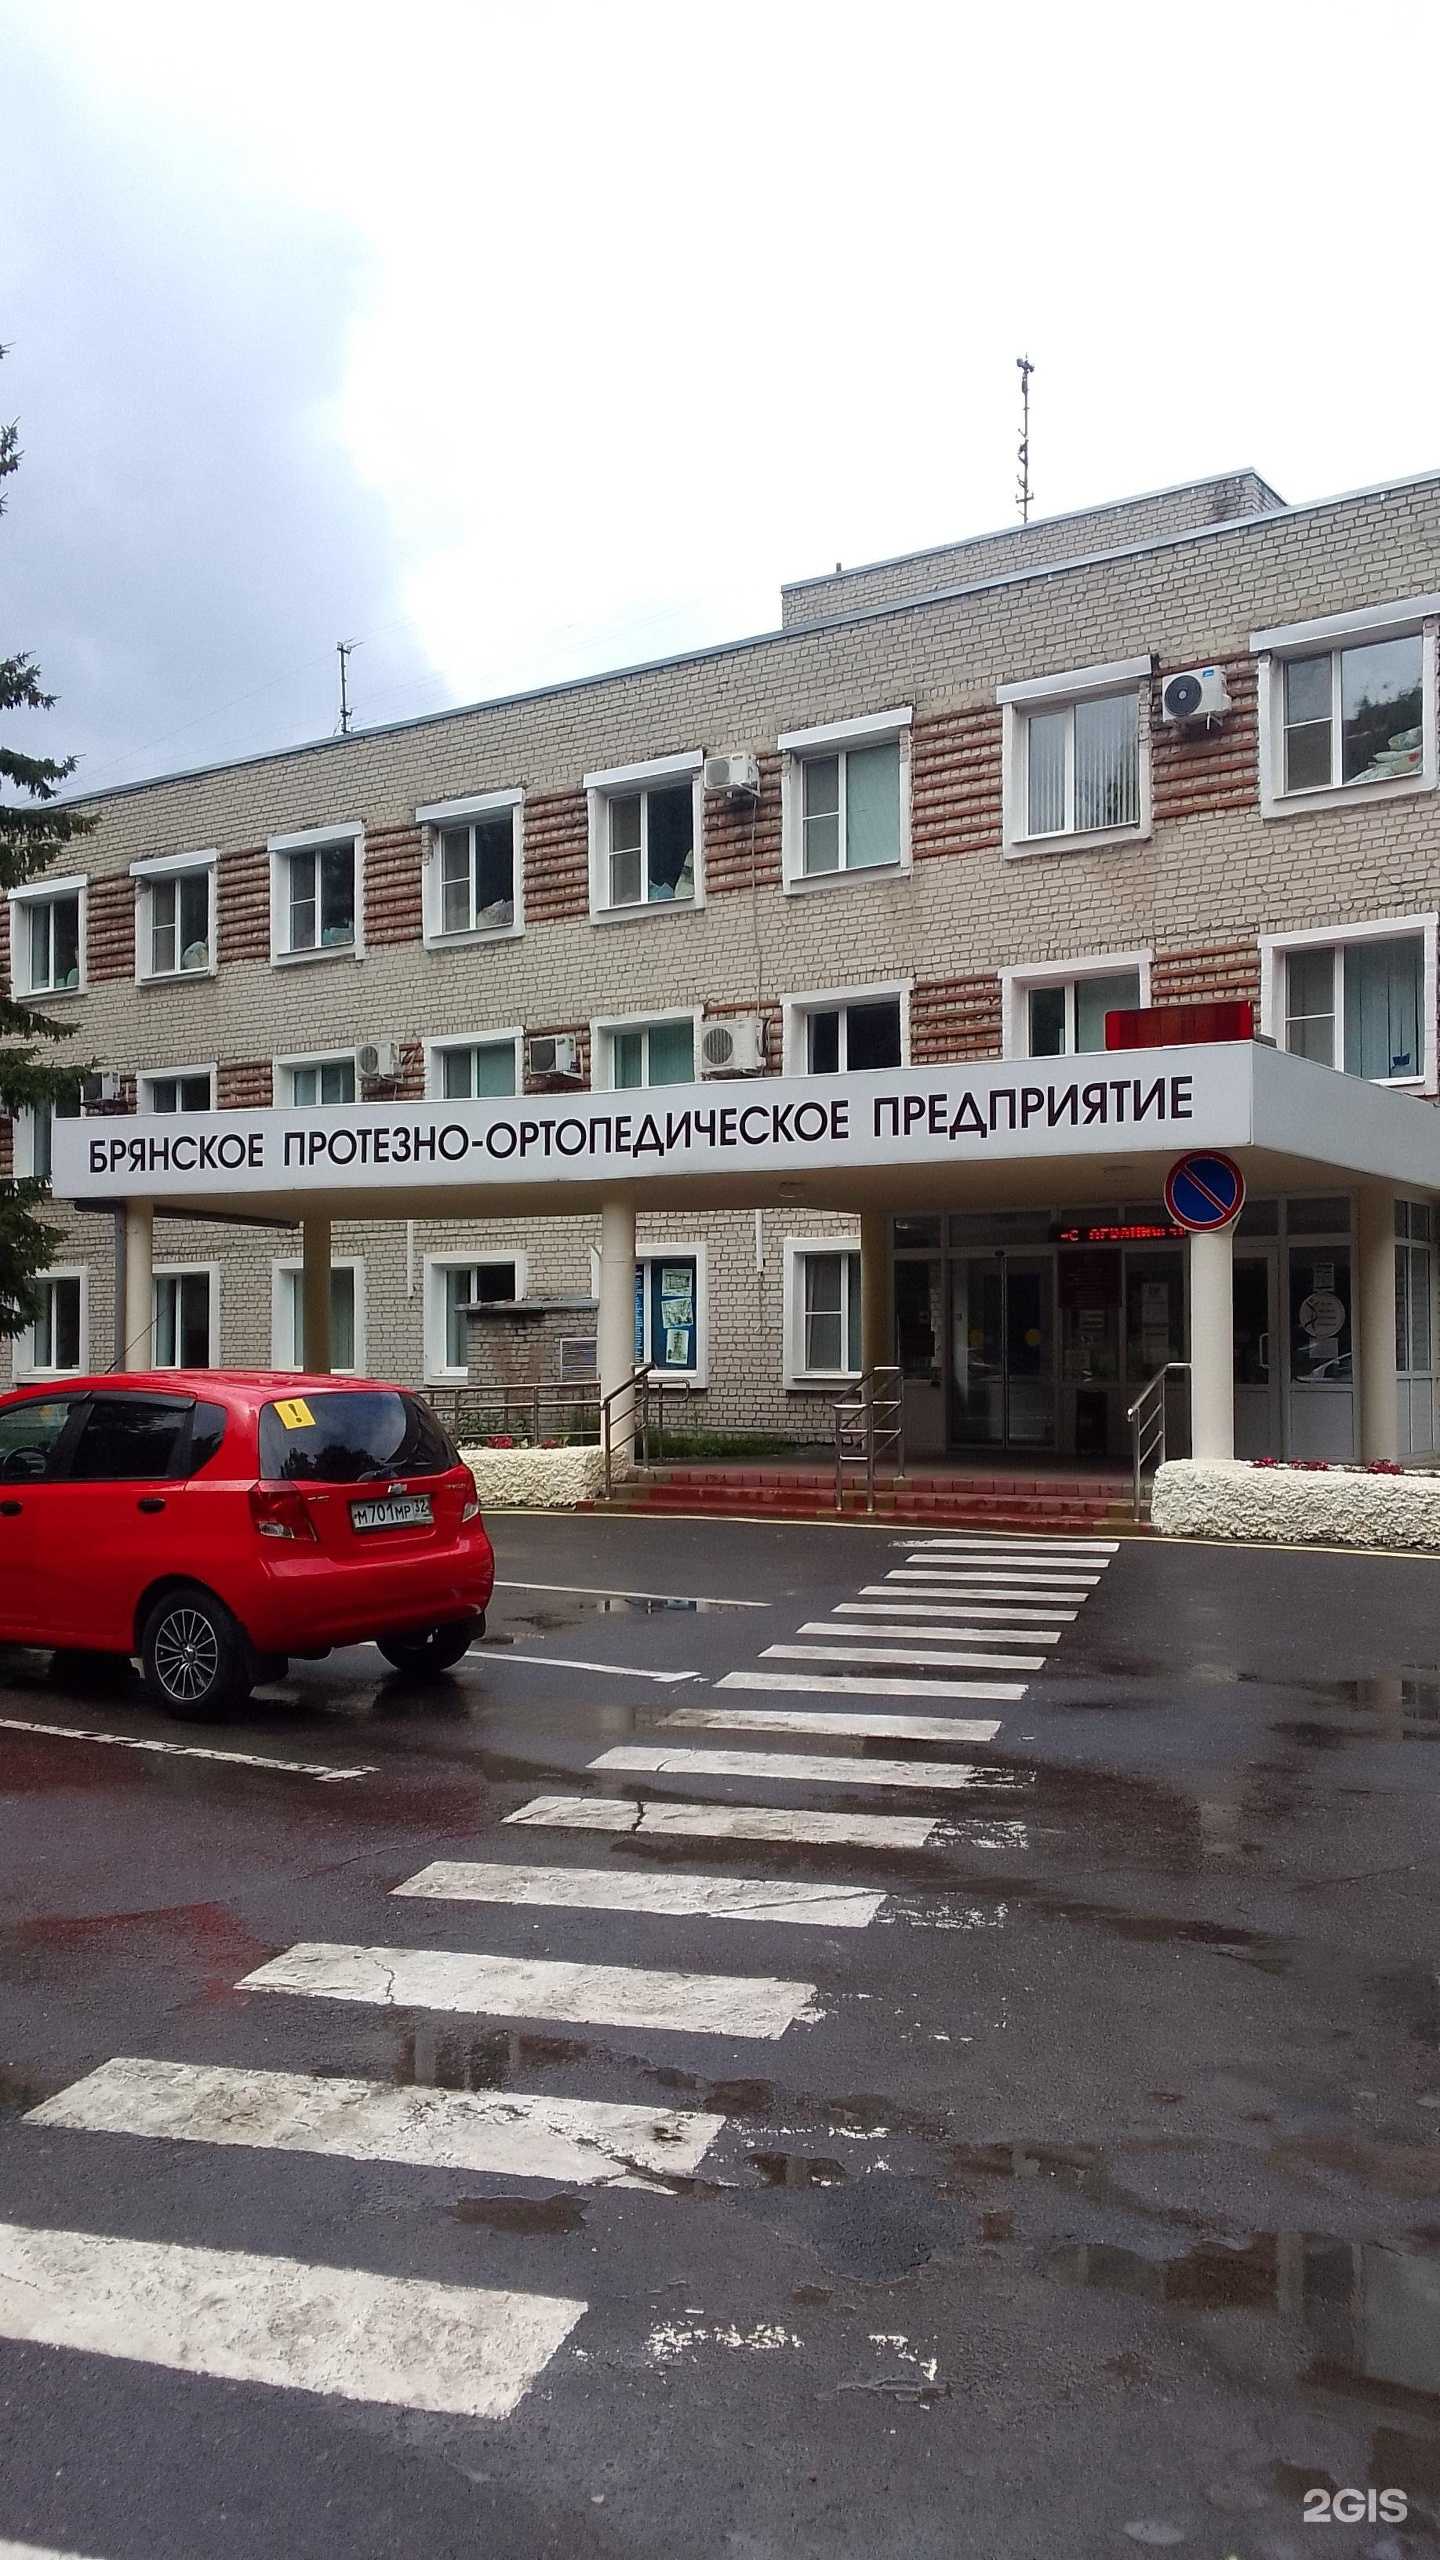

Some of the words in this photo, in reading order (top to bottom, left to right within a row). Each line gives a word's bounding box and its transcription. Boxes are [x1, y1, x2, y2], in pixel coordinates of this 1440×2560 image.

[89, 1131, 264, 1174] БРЯНСКОЕ
[284, 1099, 849, 1167] ПРОТЕЗНО-ОРТОПЕДИЧЕСКОЕ
[873, 1075, 1193, 1141] ПРЕДПРИЯТИЕ
